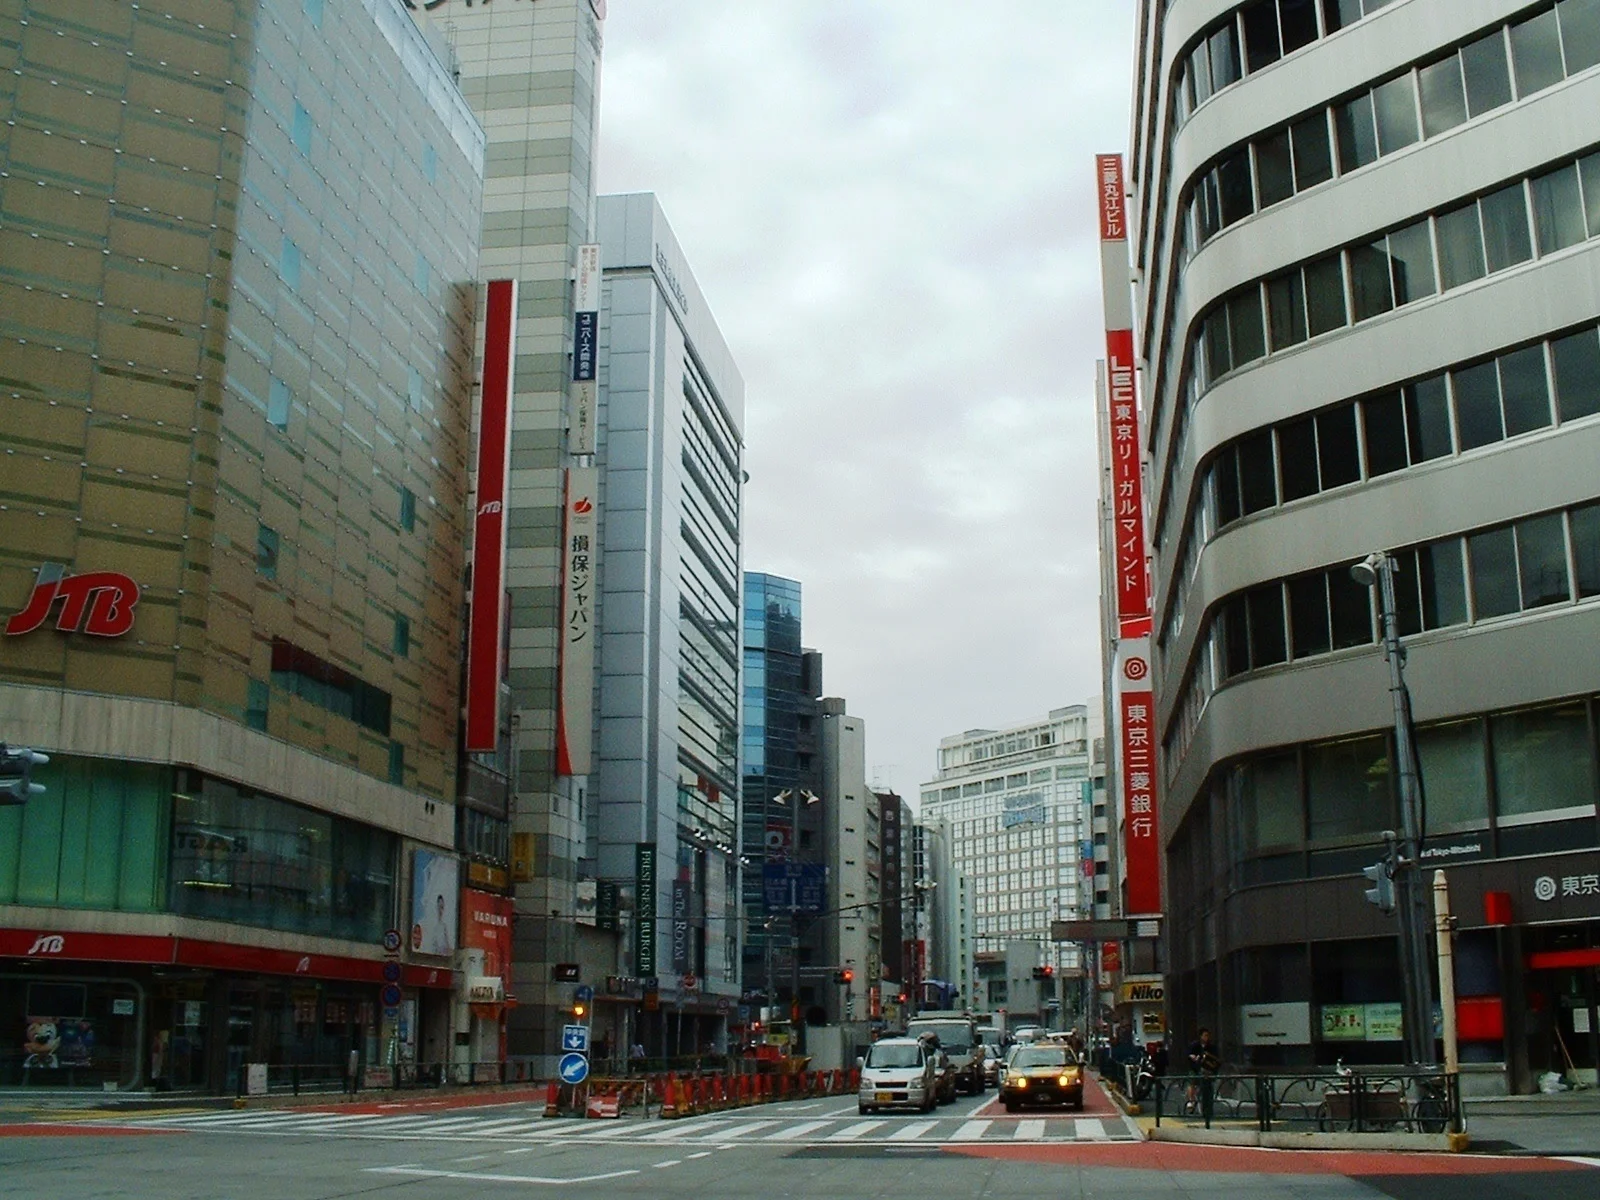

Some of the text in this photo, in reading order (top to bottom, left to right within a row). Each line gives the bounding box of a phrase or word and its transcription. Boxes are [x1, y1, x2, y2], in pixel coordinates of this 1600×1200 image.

[478, 500, 501, 515] JTB
[5, 562, 140, 637] JTB
[569, 535, 590, 643] 損保ジャパン
[1127, 704, 1153, 838] 東京三菱銀行
[1561, 874, 1600, 896] 東京
[28, 934, 65, 954] JTB
[640, 922, 653, 971] BURGER
